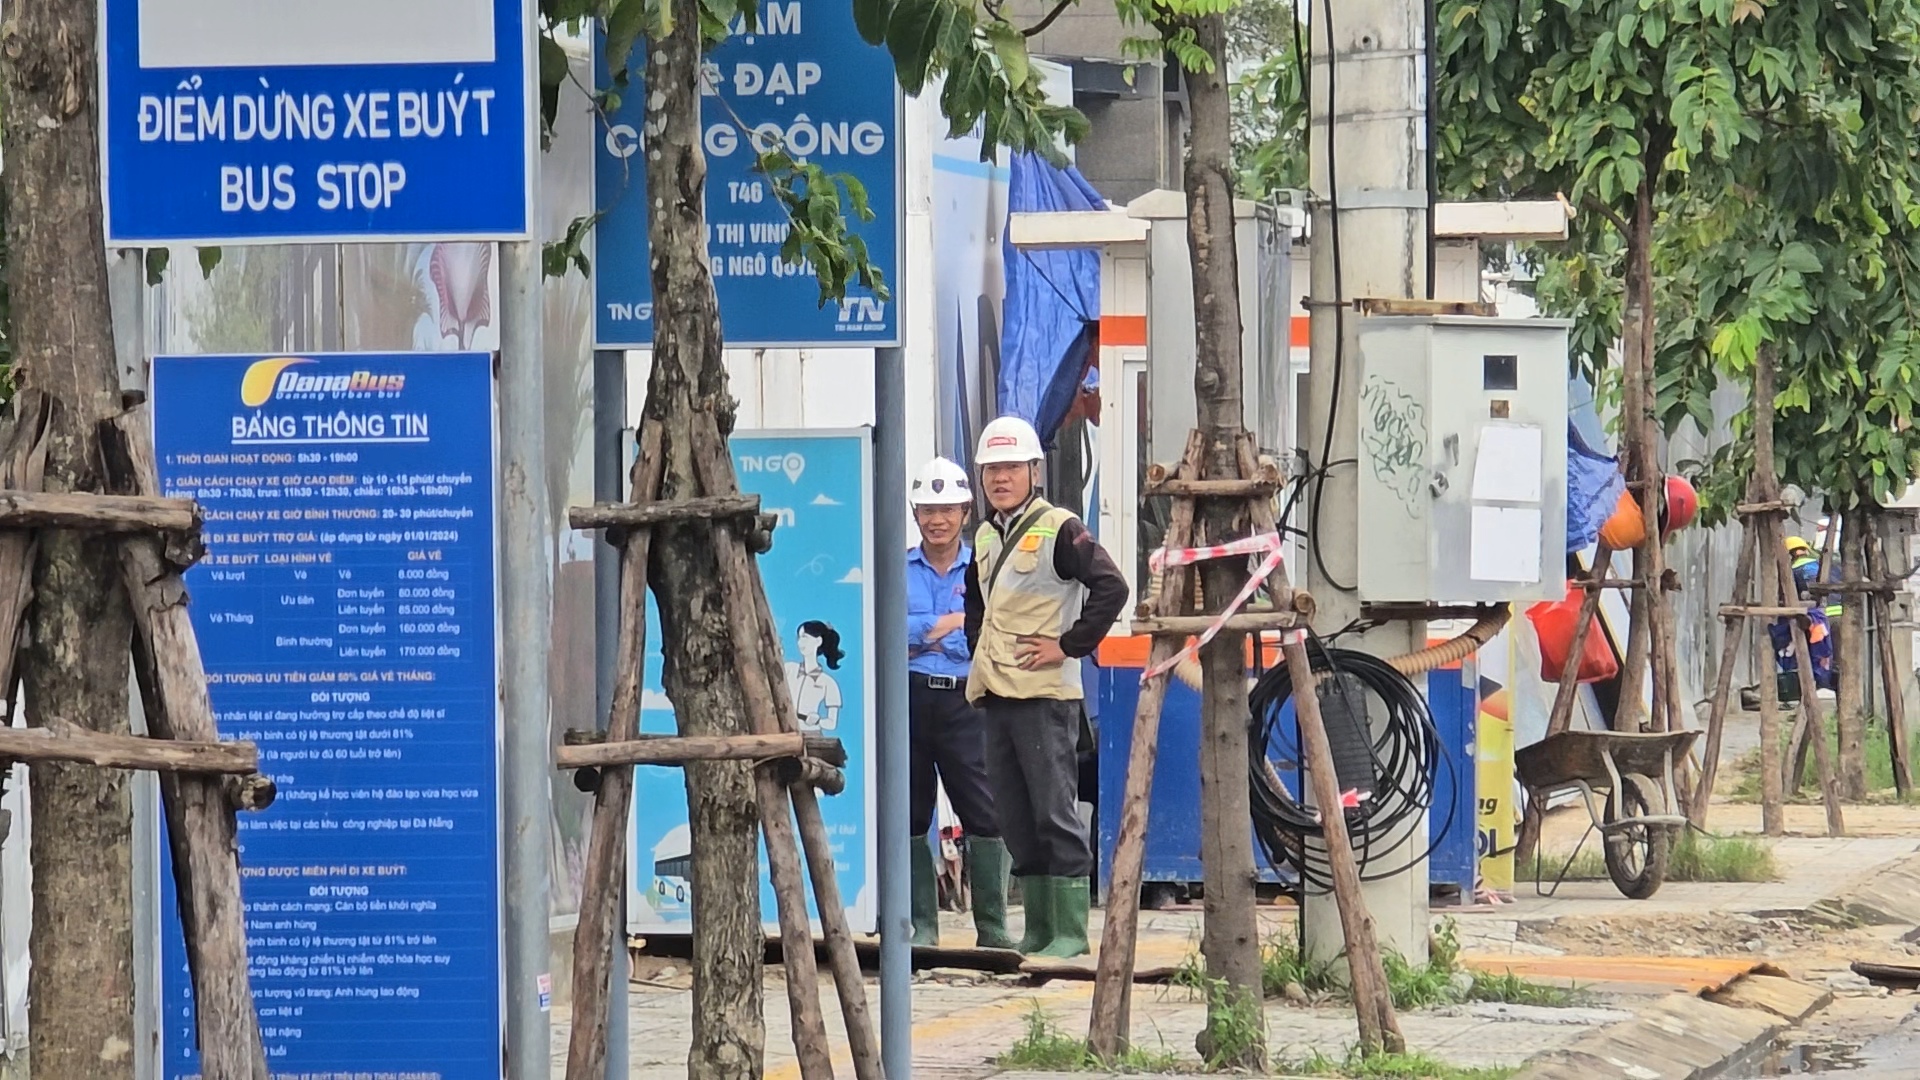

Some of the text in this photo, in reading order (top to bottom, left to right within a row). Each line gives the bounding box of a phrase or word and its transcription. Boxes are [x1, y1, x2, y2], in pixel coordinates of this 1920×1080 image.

[734, 61, 822, 105] ĐẠP
[138, 73, 495, 142] ĐIỂM DỪNG XE BUÝT
[606, 113, 885, 166] CG CỘNG
[220, 163, 406, 212] BUS STOP
[728, 182, 763, 203] T46
[716, 224, 745, 247] THỊ
[729, 252, 766, 276] NGÔ
[278, 371, 405, 392] DanaBus
[276, 391, 401, 401] Danang Urban bus
[231, 410, 428, 438] BẢNG THÔNG TIN
[177, 454, 201, 464] THỜI
[203, 454, 228, 464] GIAN
[231, 454, 259, 464] HOẠT
[262, 453, 294, 464] ĐỘNG:
[330, 453, 358, 462] 19h00
[166, 472, 472, 487] 2. CÁCH CHẠY XE GIỜ CAO từ 10 chuyến
[230, 487, 255, 498] 7h30,
[284, 487, 312, 497] 11h30
[321, 487, 351, 496] 12h30,
[205, 509, 411, 521] CÁCH CHẠY XE GIỜ BÌNH 20- 30
[213, 531, 458, 544] ĐI XE BUÝT TRỢ (áp dụng từ ngày 01/01/2024)
[216, 554, 259, 564] XE BUÝT
[265, 554, 289, 564] LOẠI
[291, 553, 316, 563] HÌNH
[408, 550, 441, 560] GIÁ VÉ
[226, 571, 245, 581] lượt
[426, 568, 449, 580] đồng
[359, 587, 384, 600] tuyến
[432, 586, 455, 599] đồng
[360, 603, 385, 616] tuyến
[432, 603, 454, 616] đồng
[224, 613, 253, 624] Tháng
[361, 622, 386, 635] tuyến
[437, 622, 460, 635] đồng
[299, 637, 332, 648] thường
[361, 645, 386, 658] tuyến
[400, 645, 460, 657] 170.000 đồng
[225, 673, 263, 684] TƯỢNG
[284, 671, 306, 682] TIÊN
[360, 671, 378, 681] GIÁ
[397, 670, 435, 681] THÁNG:
[332, 692, 370, 703] TƯỢNG
[275, 711, 297, 722] đang
[407, 709, 419, 719] độ
[286, 731, 297, 740] có
[320, 731, 353, 741] thương
[393, 729, 413, 738] 81%
[280, 749, 347, 761] người 60
[332, 790, 349, 800] học
[405, 790, 420, 799] tạo
[442, 789, 458, 799] học
[269, 820, 288, 830] việc
[303, 820, 319, 829] các
[321, 820, 338, 828] khu
[343, 819, 365, 830] công
[268, 867, 299, 877] ĐƯỢC
[330, 865, 347, 876] PHÍ
[362, 866, 375, 875] XE
[330, 886, 368, 897] TƯỢNG
[281, 901, 368, 911] cách bộ
[251, 920, 292, 929] Nam anh
[289, 937, 300, 946] có
[323, 937, 356, 947] thương
[384, 935, 405, 945] 81%
[255, 954, 432, 968] động bị độc học
[284, 966, 341, 978] động 81%
[184, 987, 419, 998] 5 Anh động
[183, 1007, 276, 1017] 6 con
[184, 1028, 189, 1037] 7
